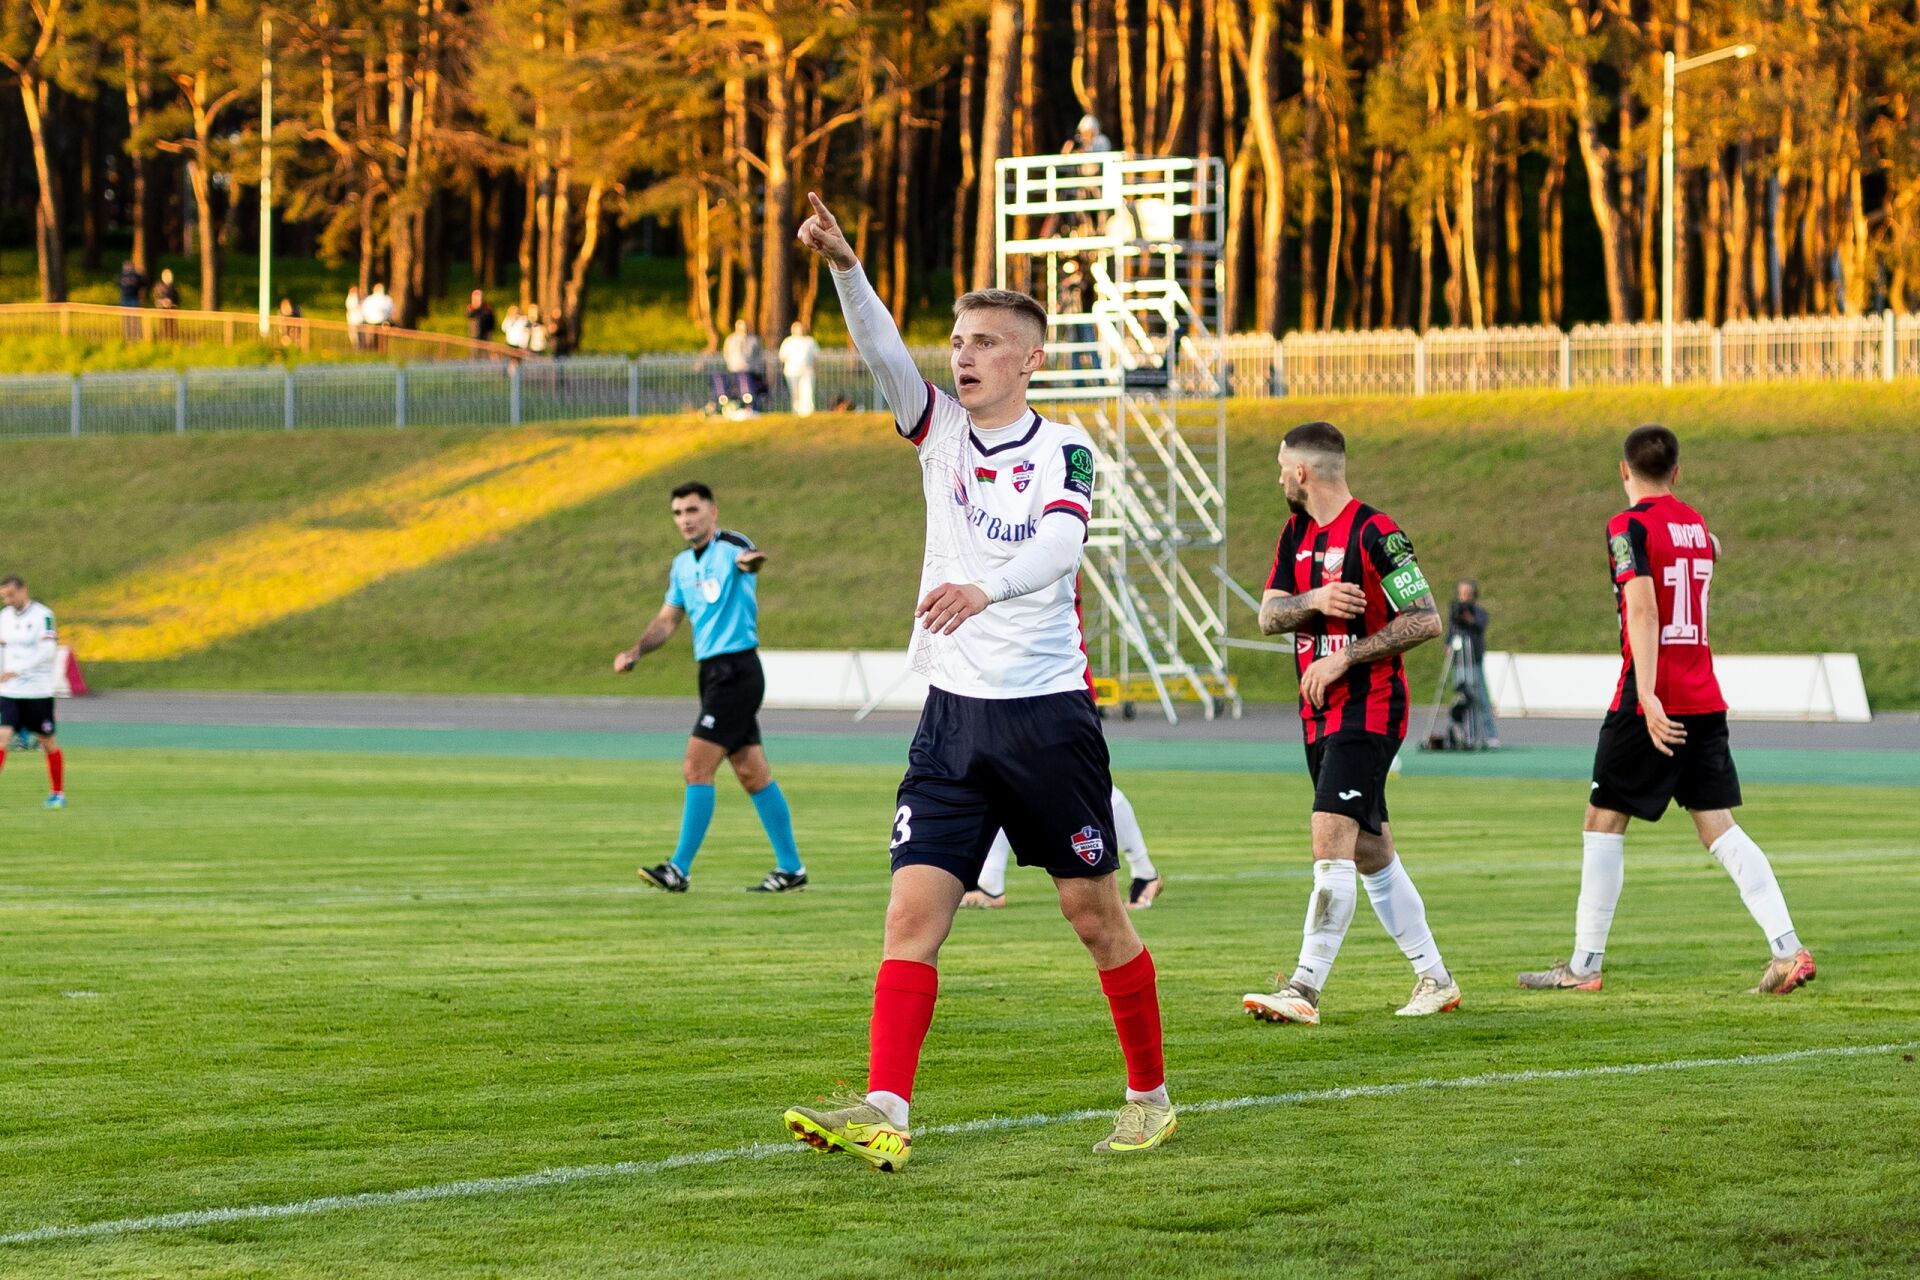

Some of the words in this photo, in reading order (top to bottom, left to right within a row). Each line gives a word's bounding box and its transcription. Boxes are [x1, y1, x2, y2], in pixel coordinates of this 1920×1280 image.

[1393, 571, 1412, 589] 80
[1661, 557, 1713, 646] 17
[889, 805, 912, 849] 3
